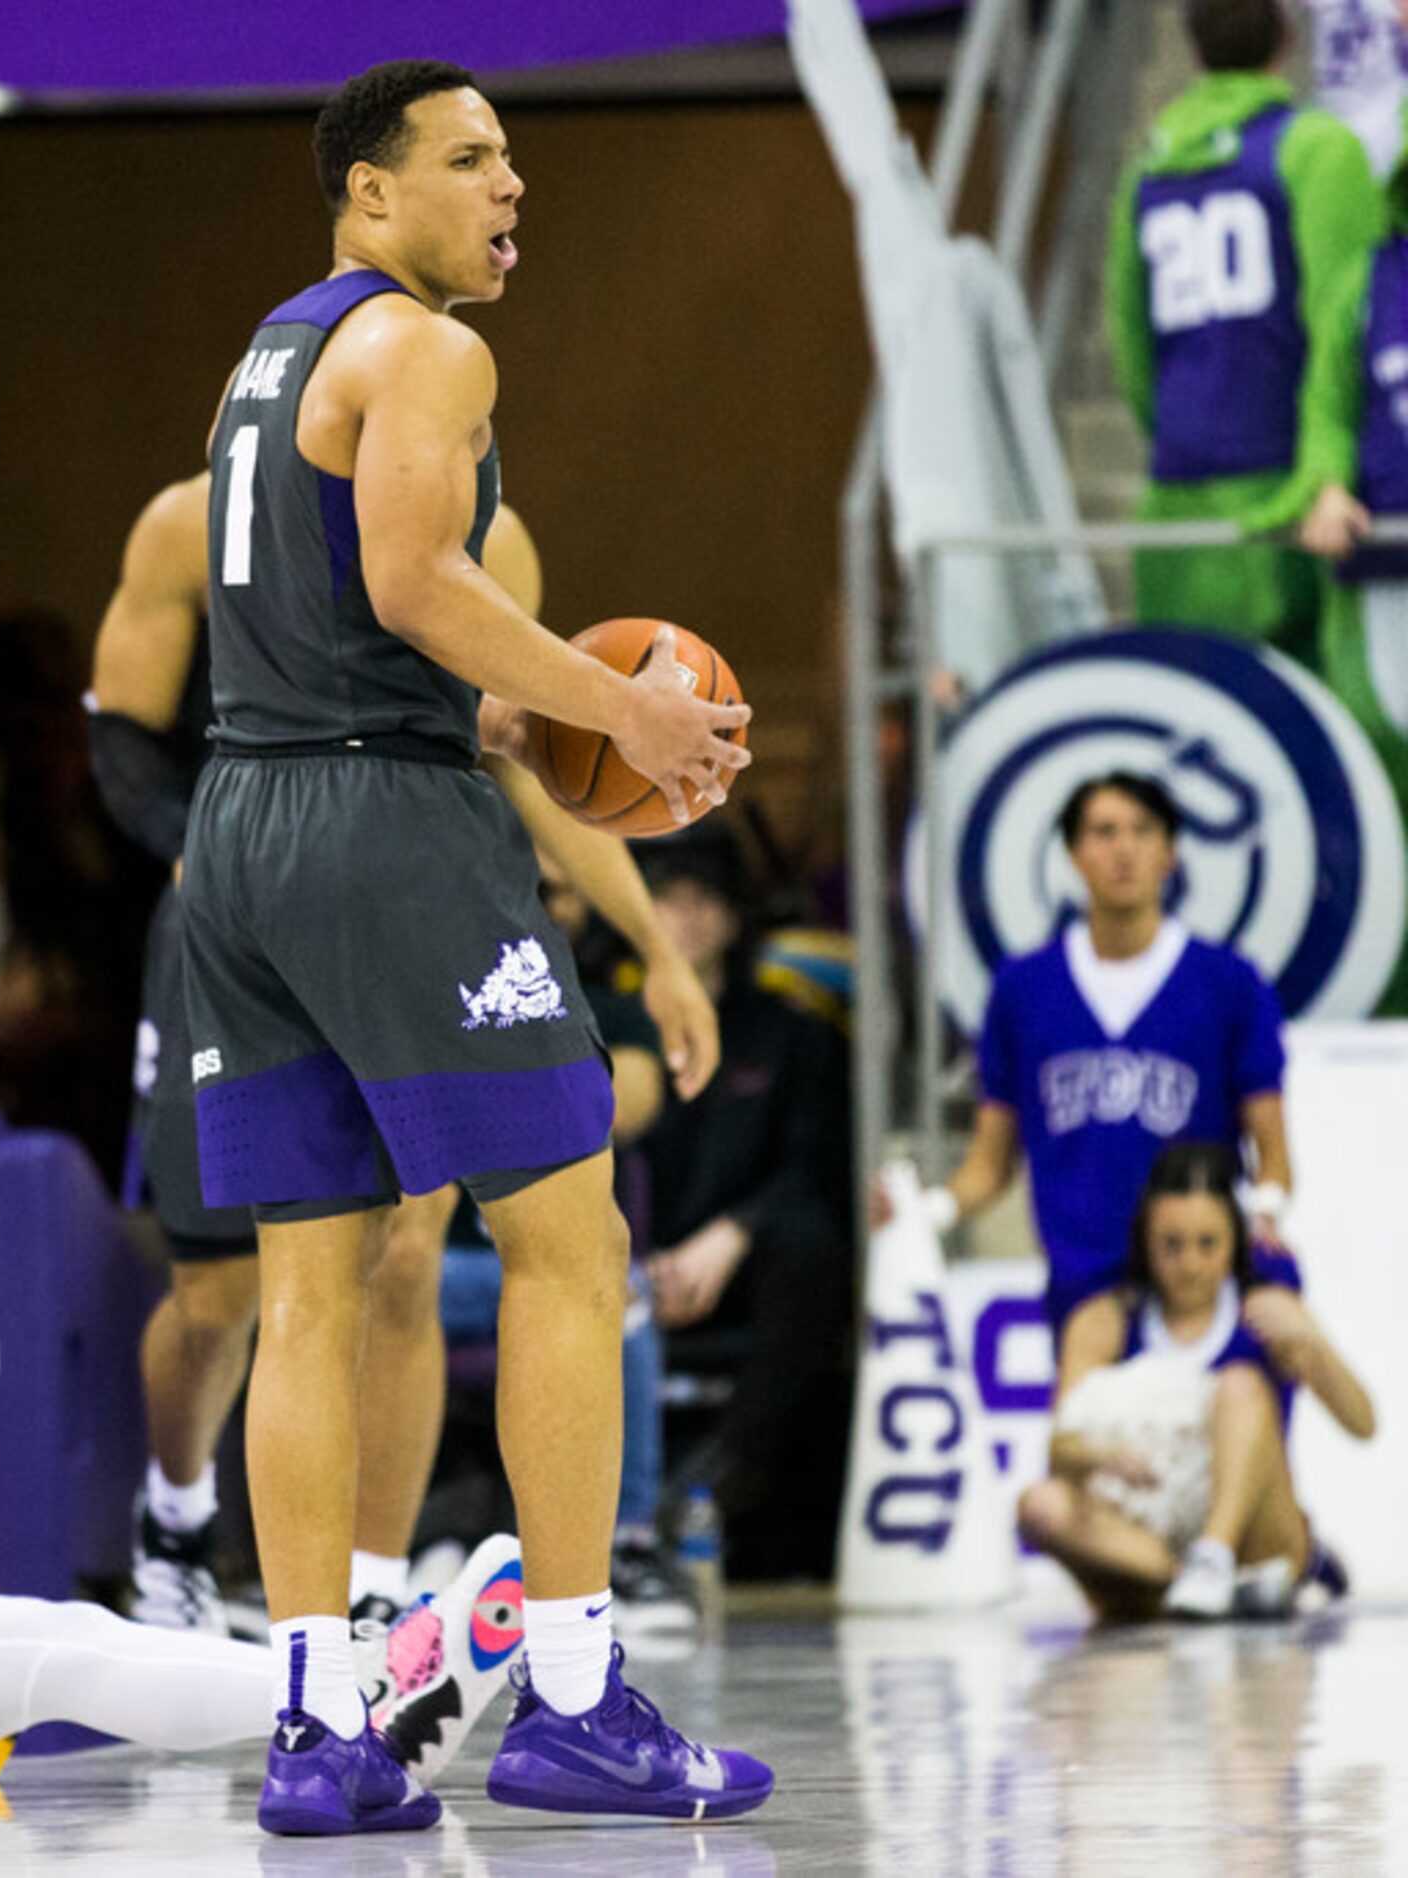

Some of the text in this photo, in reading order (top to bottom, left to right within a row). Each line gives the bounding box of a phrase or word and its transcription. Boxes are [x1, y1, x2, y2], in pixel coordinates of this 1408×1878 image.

[1142, 192, 1276, 333] 20
[222, 426, 259, 584] 1
[866, 1291, 963, 1553] TCU
